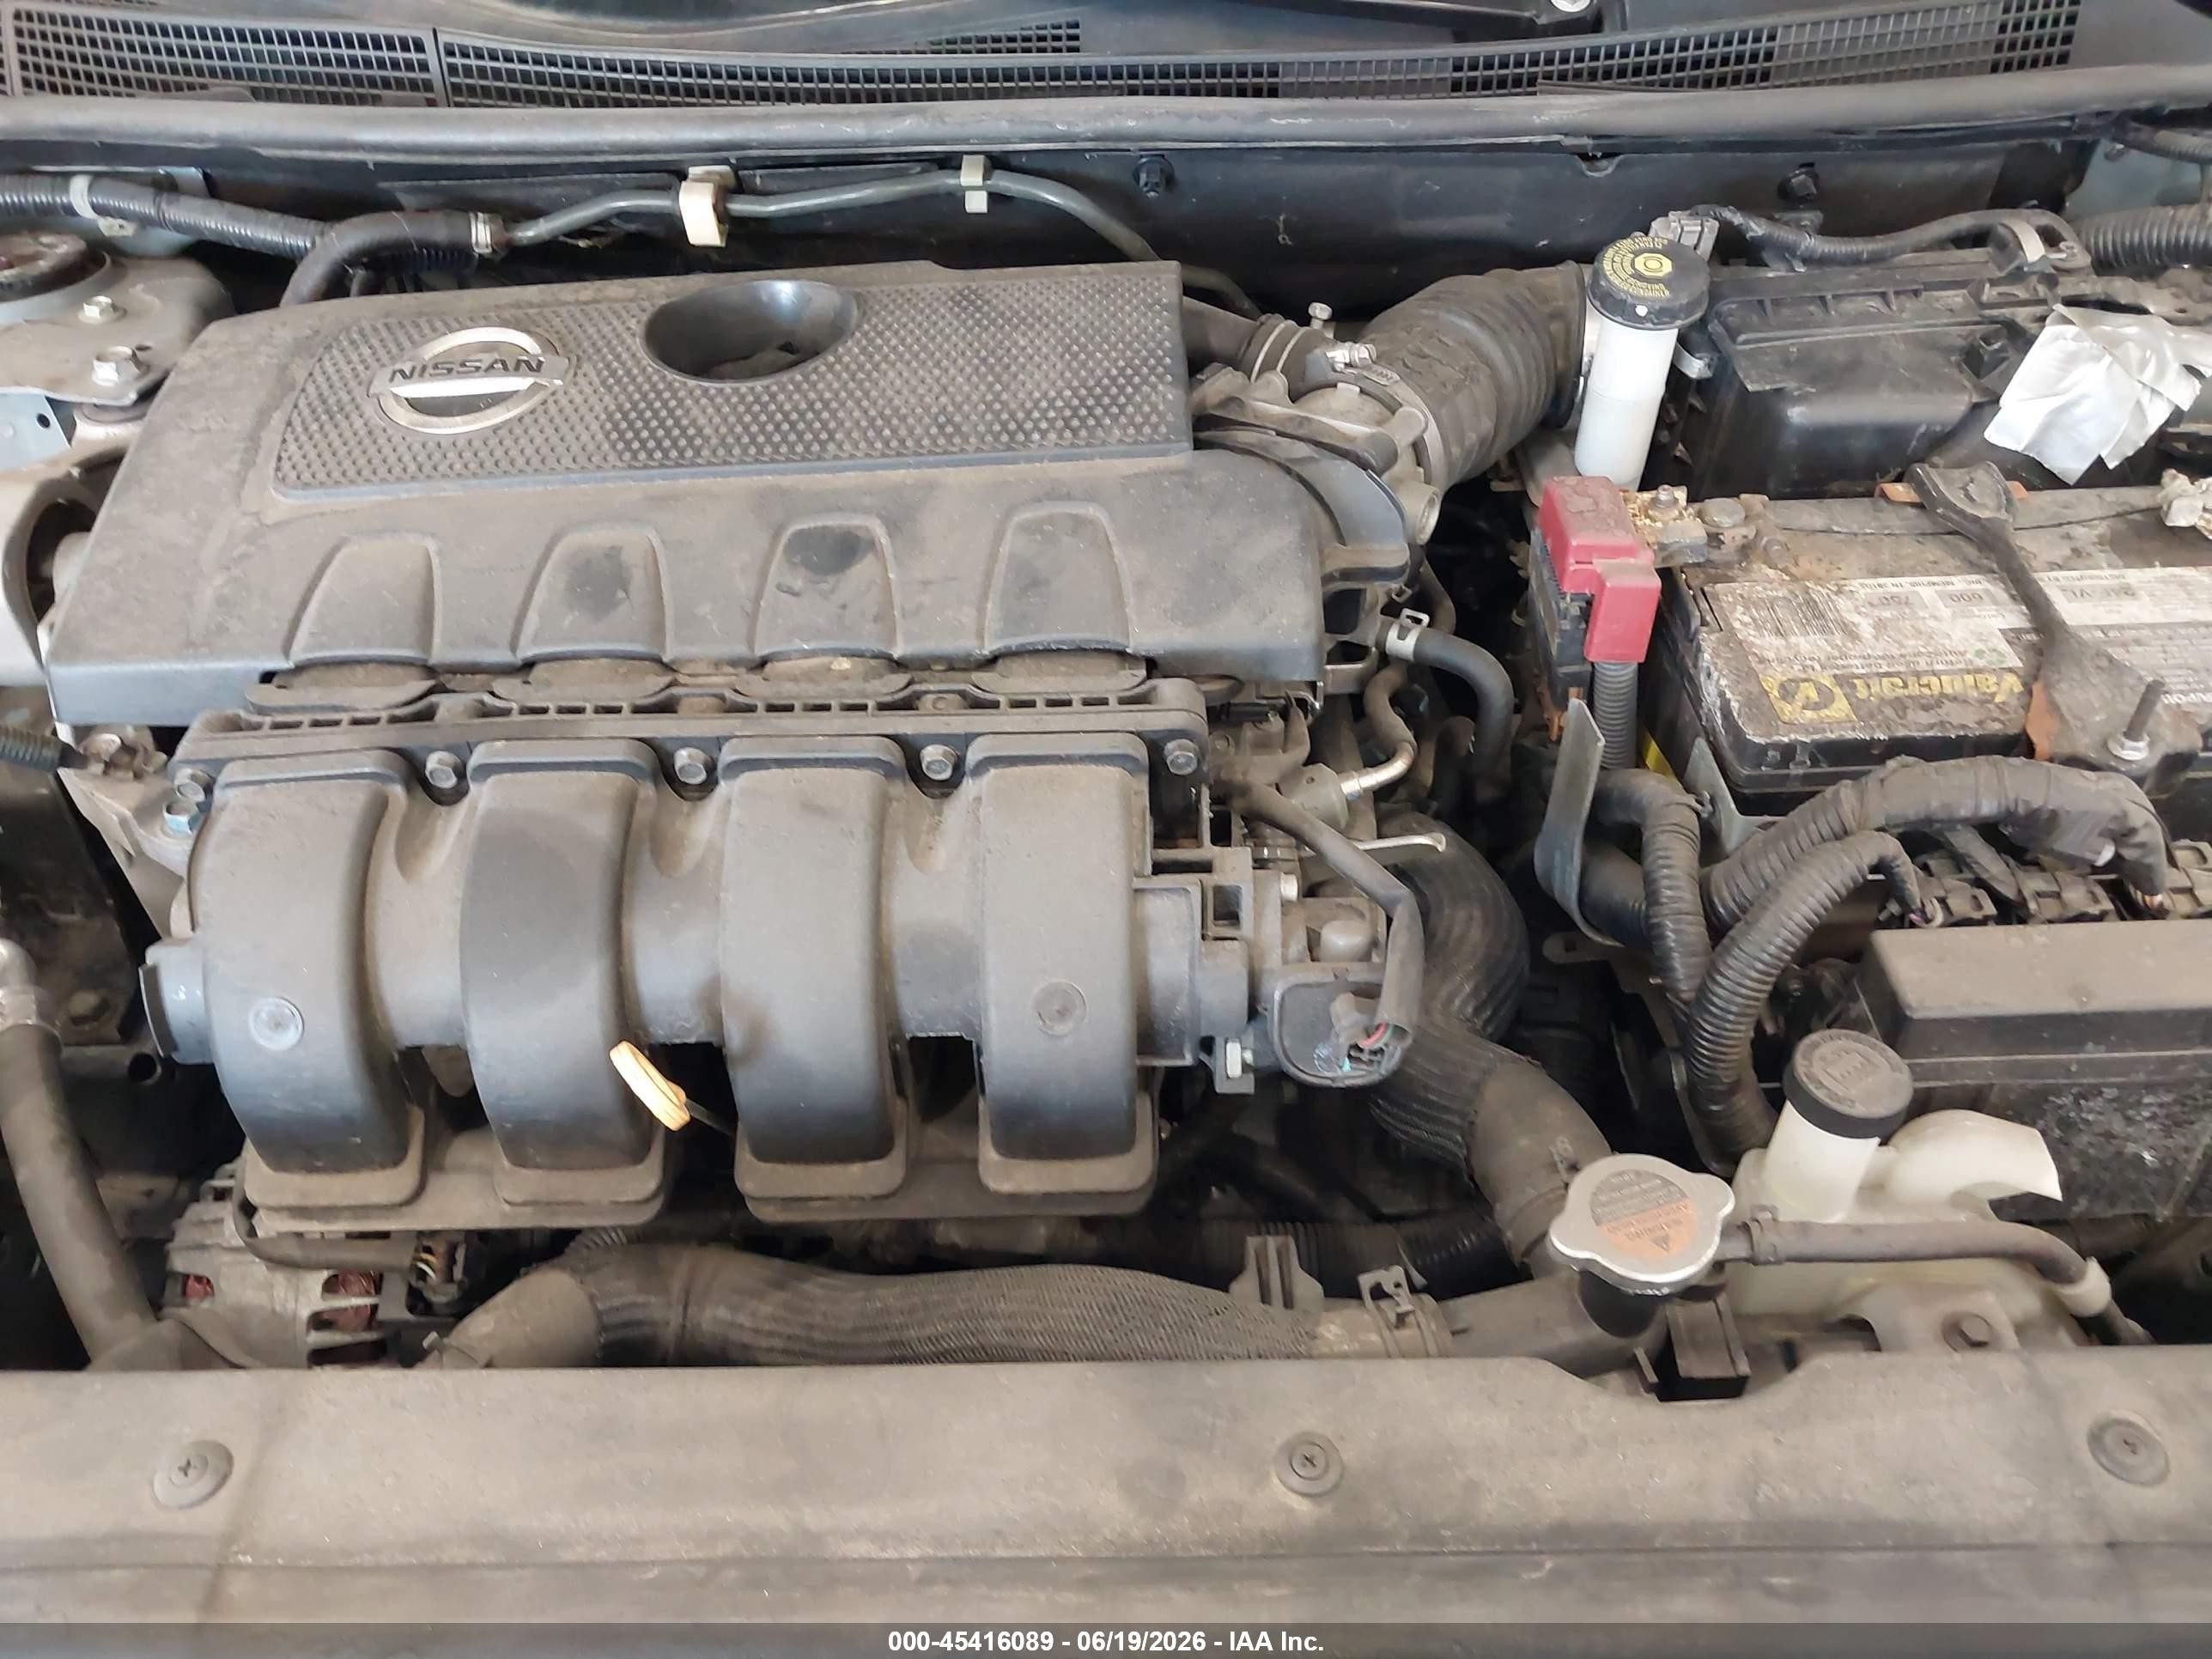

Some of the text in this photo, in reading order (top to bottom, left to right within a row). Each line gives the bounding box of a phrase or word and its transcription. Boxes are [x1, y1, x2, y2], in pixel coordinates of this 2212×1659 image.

[388, 356, 546, 383] NISSAN
[1949, 592, 1984, 605] 600
[1924, 658, 1972, 667] Return
[1850, 672, 2024, 703] Valucraft
